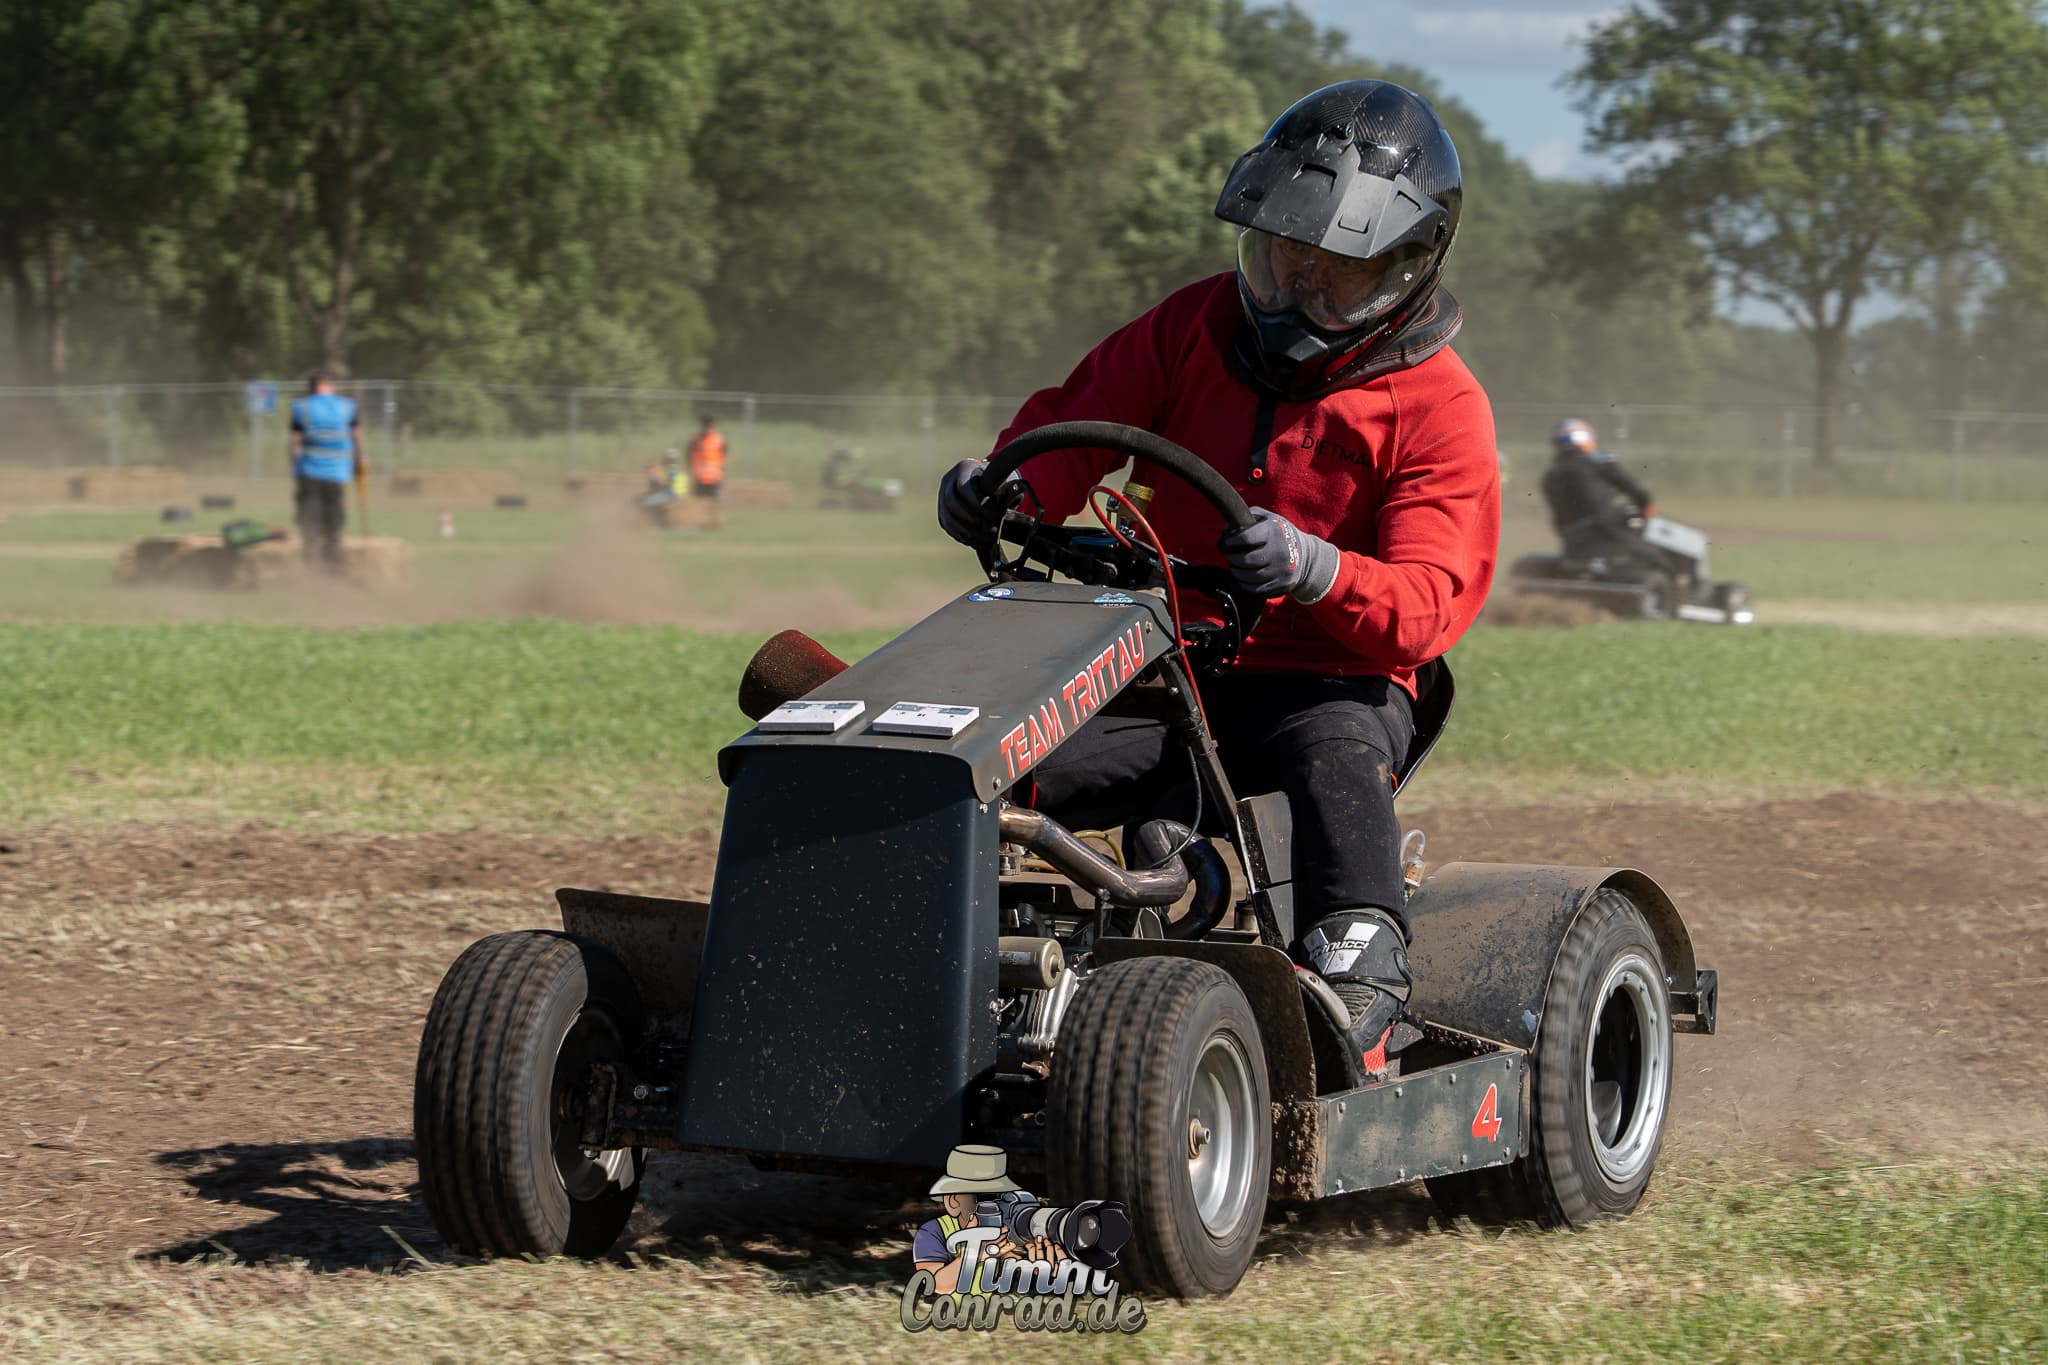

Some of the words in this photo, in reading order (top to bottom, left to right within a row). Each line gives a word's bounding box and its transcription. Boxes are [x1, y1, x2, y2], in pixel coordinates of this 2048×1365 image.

[1001, 697, 1066, 780] TEAM
[1062, 621, 1145, 726] TRITTAU
[1471, 1083, 1502, 1142] 4
